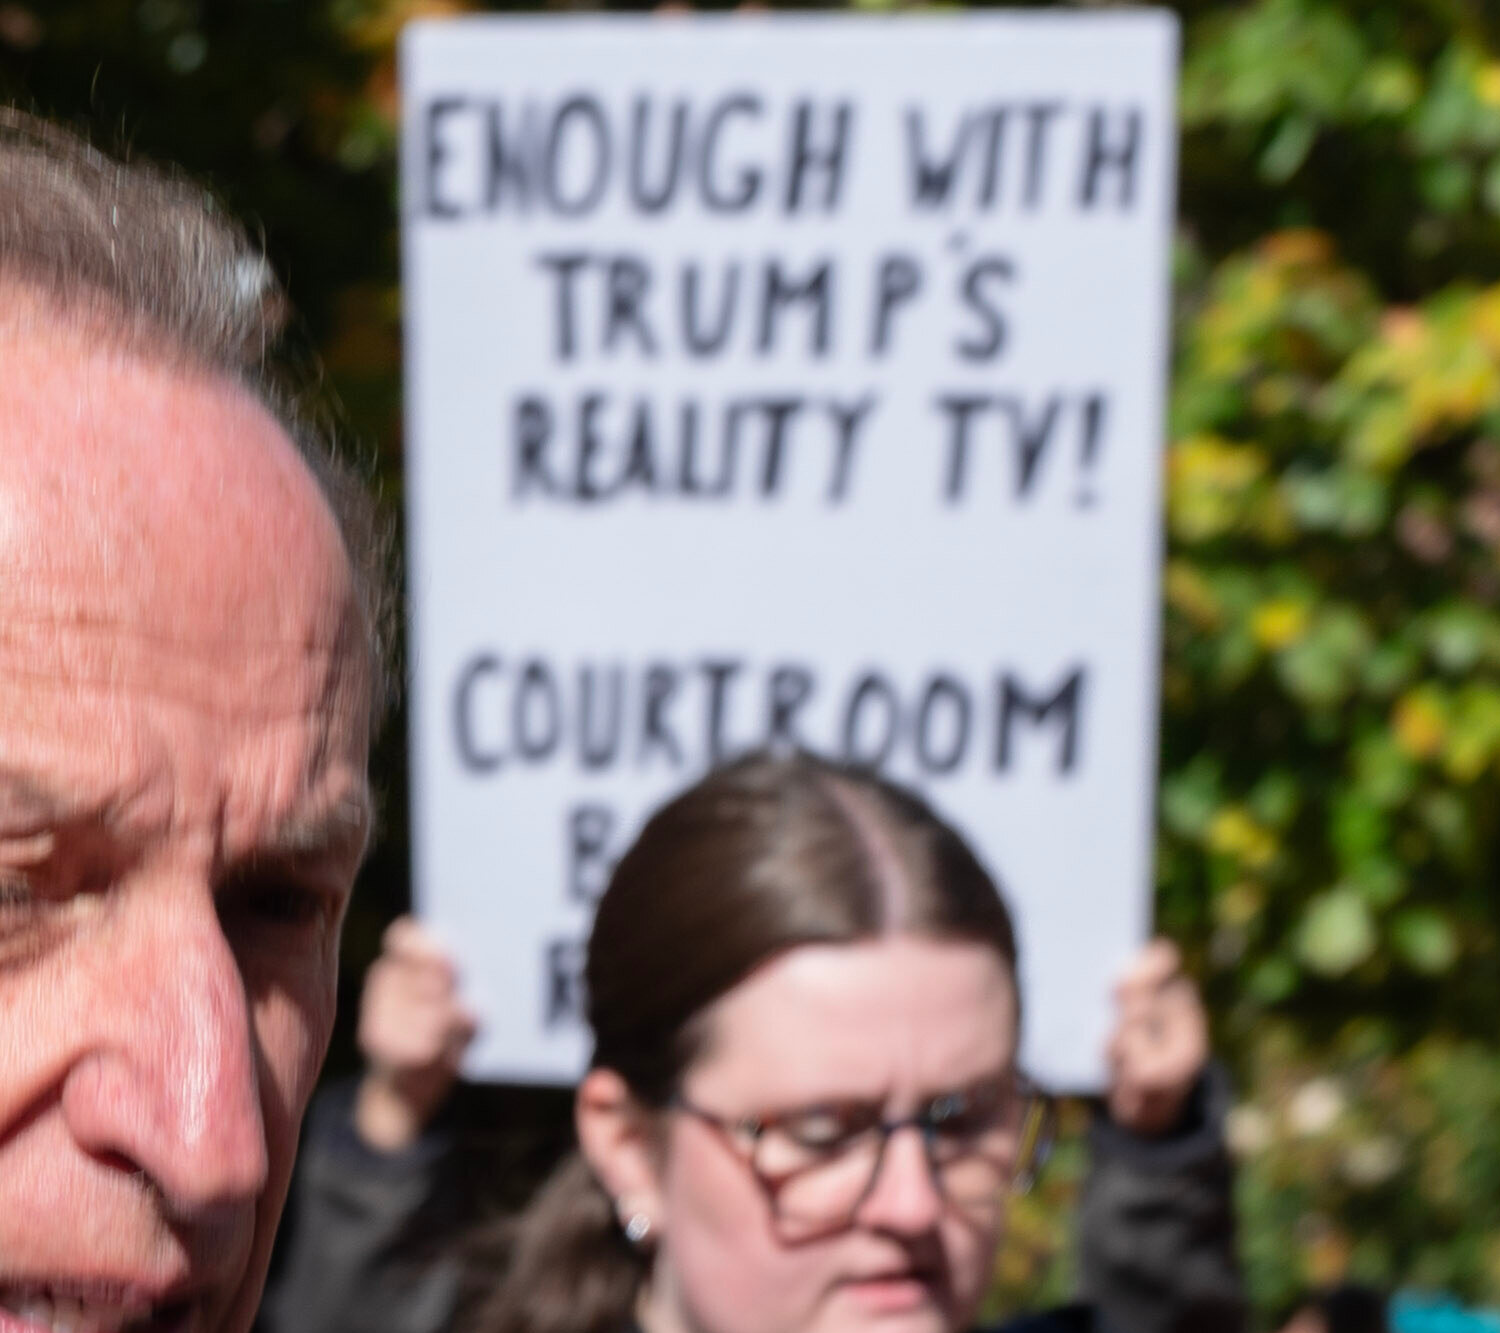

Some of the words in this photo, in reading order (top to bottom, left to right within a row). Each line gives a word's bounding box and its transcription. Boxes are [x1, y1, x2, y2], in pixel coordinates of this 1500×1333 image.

[419, 92, 853, 222] ENOUGH
[902, 101, 1146, 214] WITH
[536, 232, 1017, 364] TRUMP'S
[511, 391, 878, 509] REALITY
[934, 389, 1107, 512] TV!
[453, 652, 1088, 779] COURTROOM
